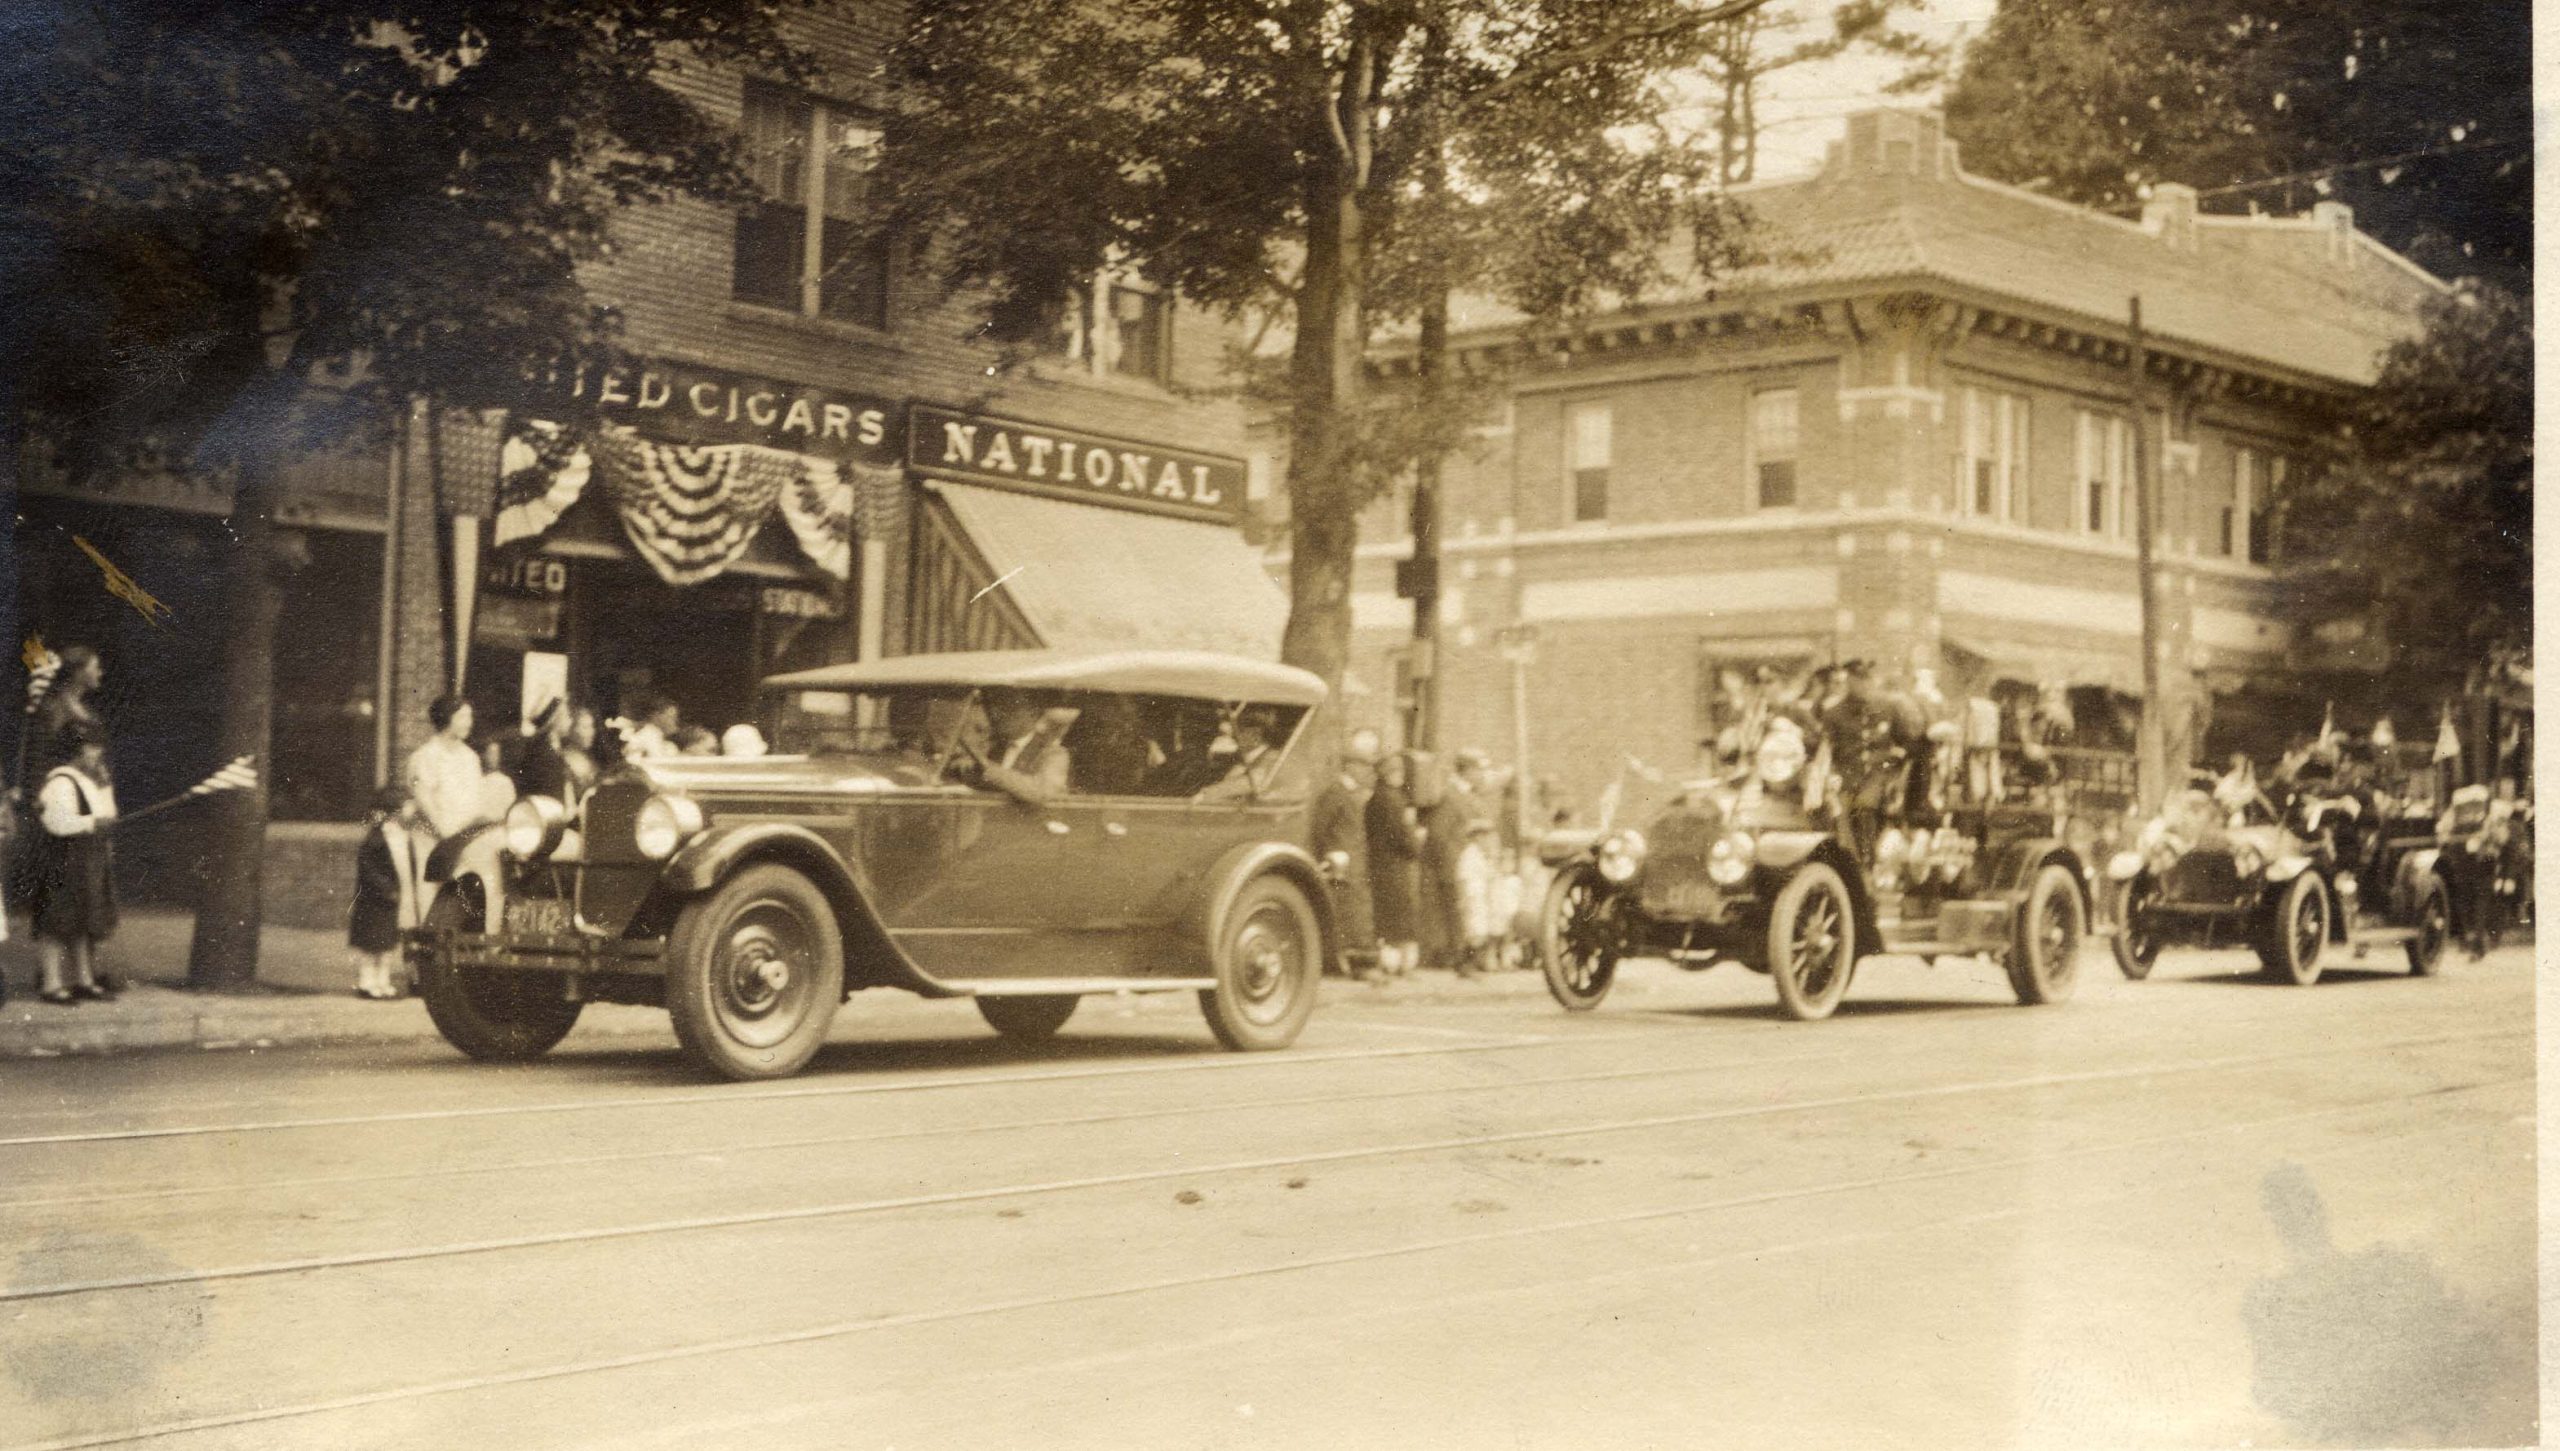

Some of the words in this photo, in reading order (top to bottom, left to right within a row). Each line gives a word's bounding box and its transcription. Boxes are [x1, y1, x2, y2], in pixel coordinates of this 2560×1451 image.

[518, 350, 671, 409] ITED
[689, 383, 887, 446] CIGARS
[943, 421, 1221, 505] NATIONAL
